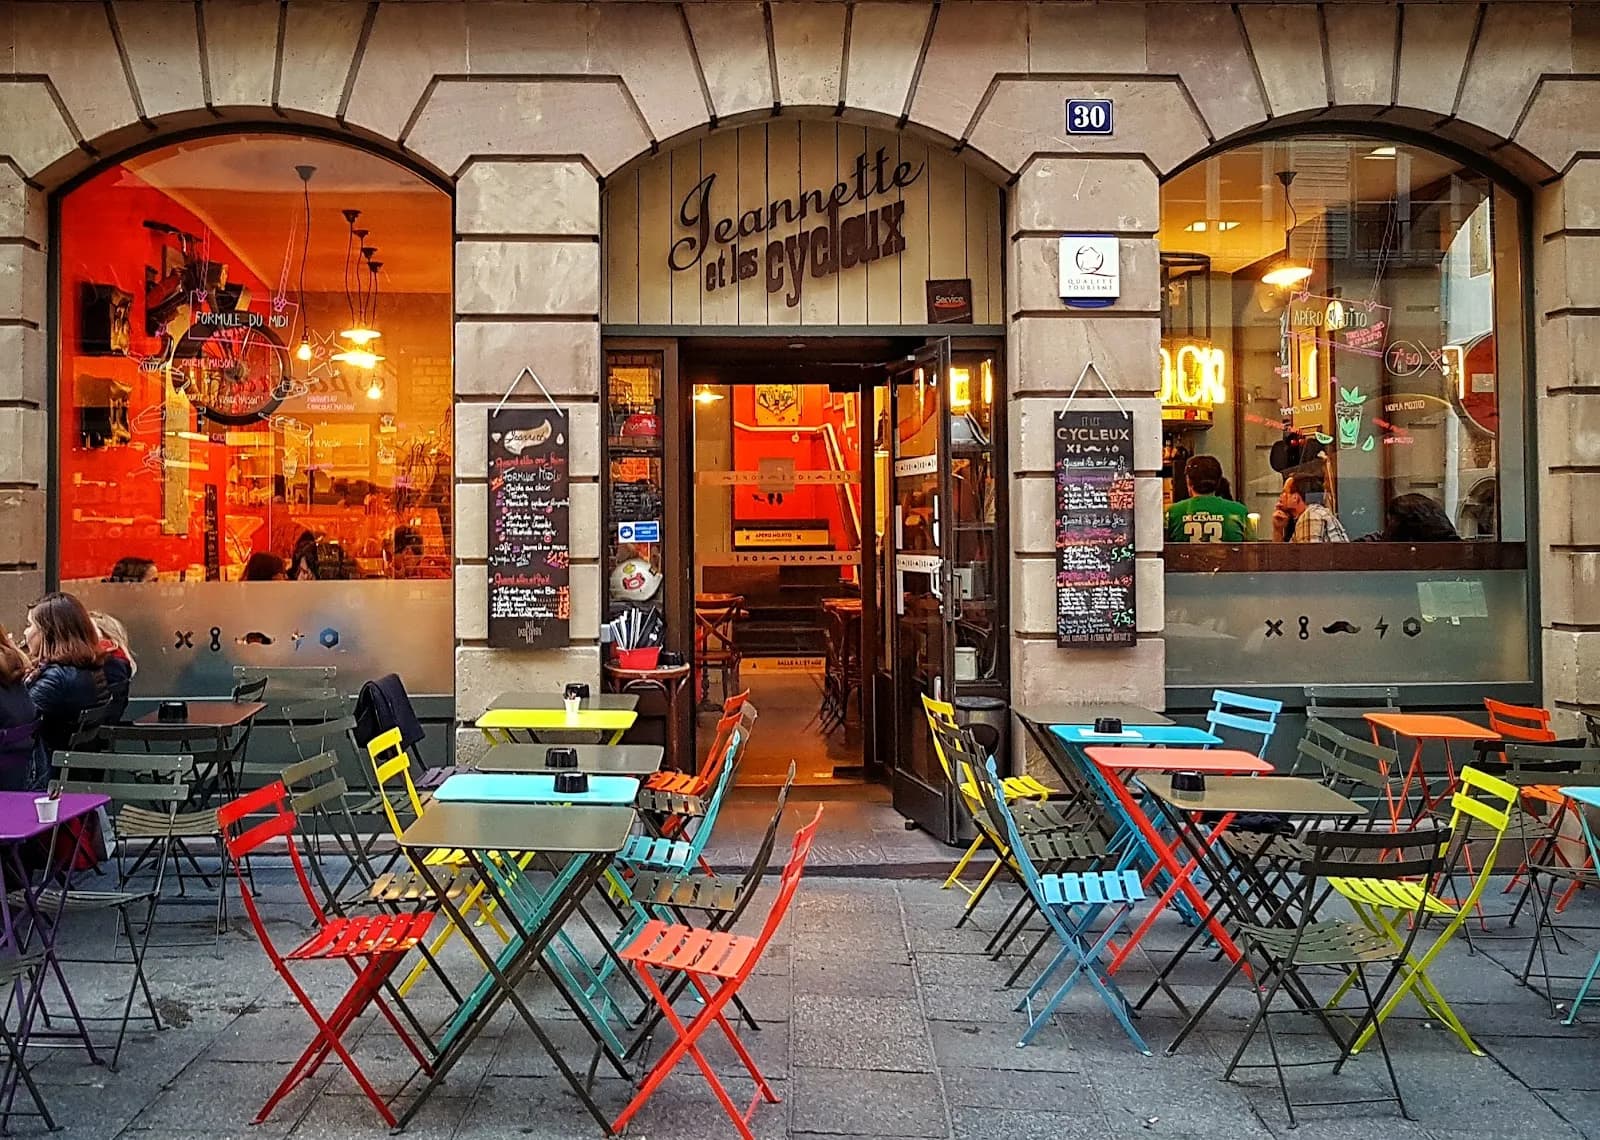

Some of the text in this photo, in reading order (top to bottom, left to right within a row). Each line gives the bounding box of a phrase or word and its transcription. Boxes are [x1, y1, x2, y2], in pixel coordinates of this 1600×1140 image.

[1074, 105, 1105, 128] 30
[668, 147, 925, 271] Jeannette
[706, 251, 726, 291] et
[766, 200, 906, 308] cycleux
[194, 311, 289, 328] FORMULE DU MIDI
[1294, 308, 1323, 327] APÉRO
[1057, 428, 1129, 440] CYCLEUX
